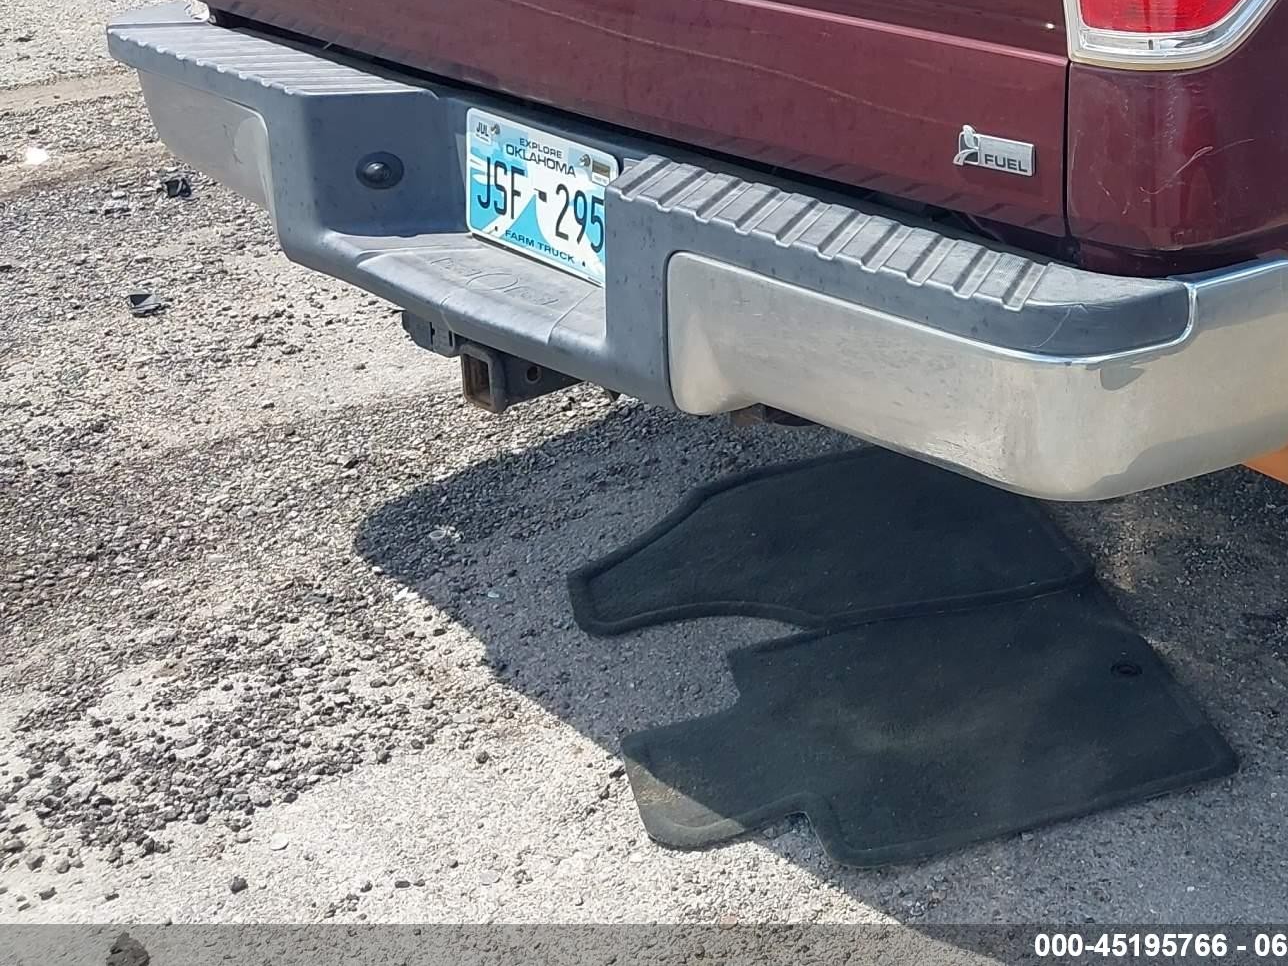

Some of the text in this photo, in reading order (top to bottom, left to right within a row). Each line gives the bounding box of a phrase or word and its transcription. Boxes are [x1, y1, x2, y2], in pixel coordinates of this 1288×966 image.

[476, 121, 489, 137] JUL
[519, 137, 562, 159] EXPLORE
[505, 144, 576, 178] OKLAHOMA
[984, 153, 1028, 173] FUEL
[505, 229, 576, 264] FARM TRUCK
